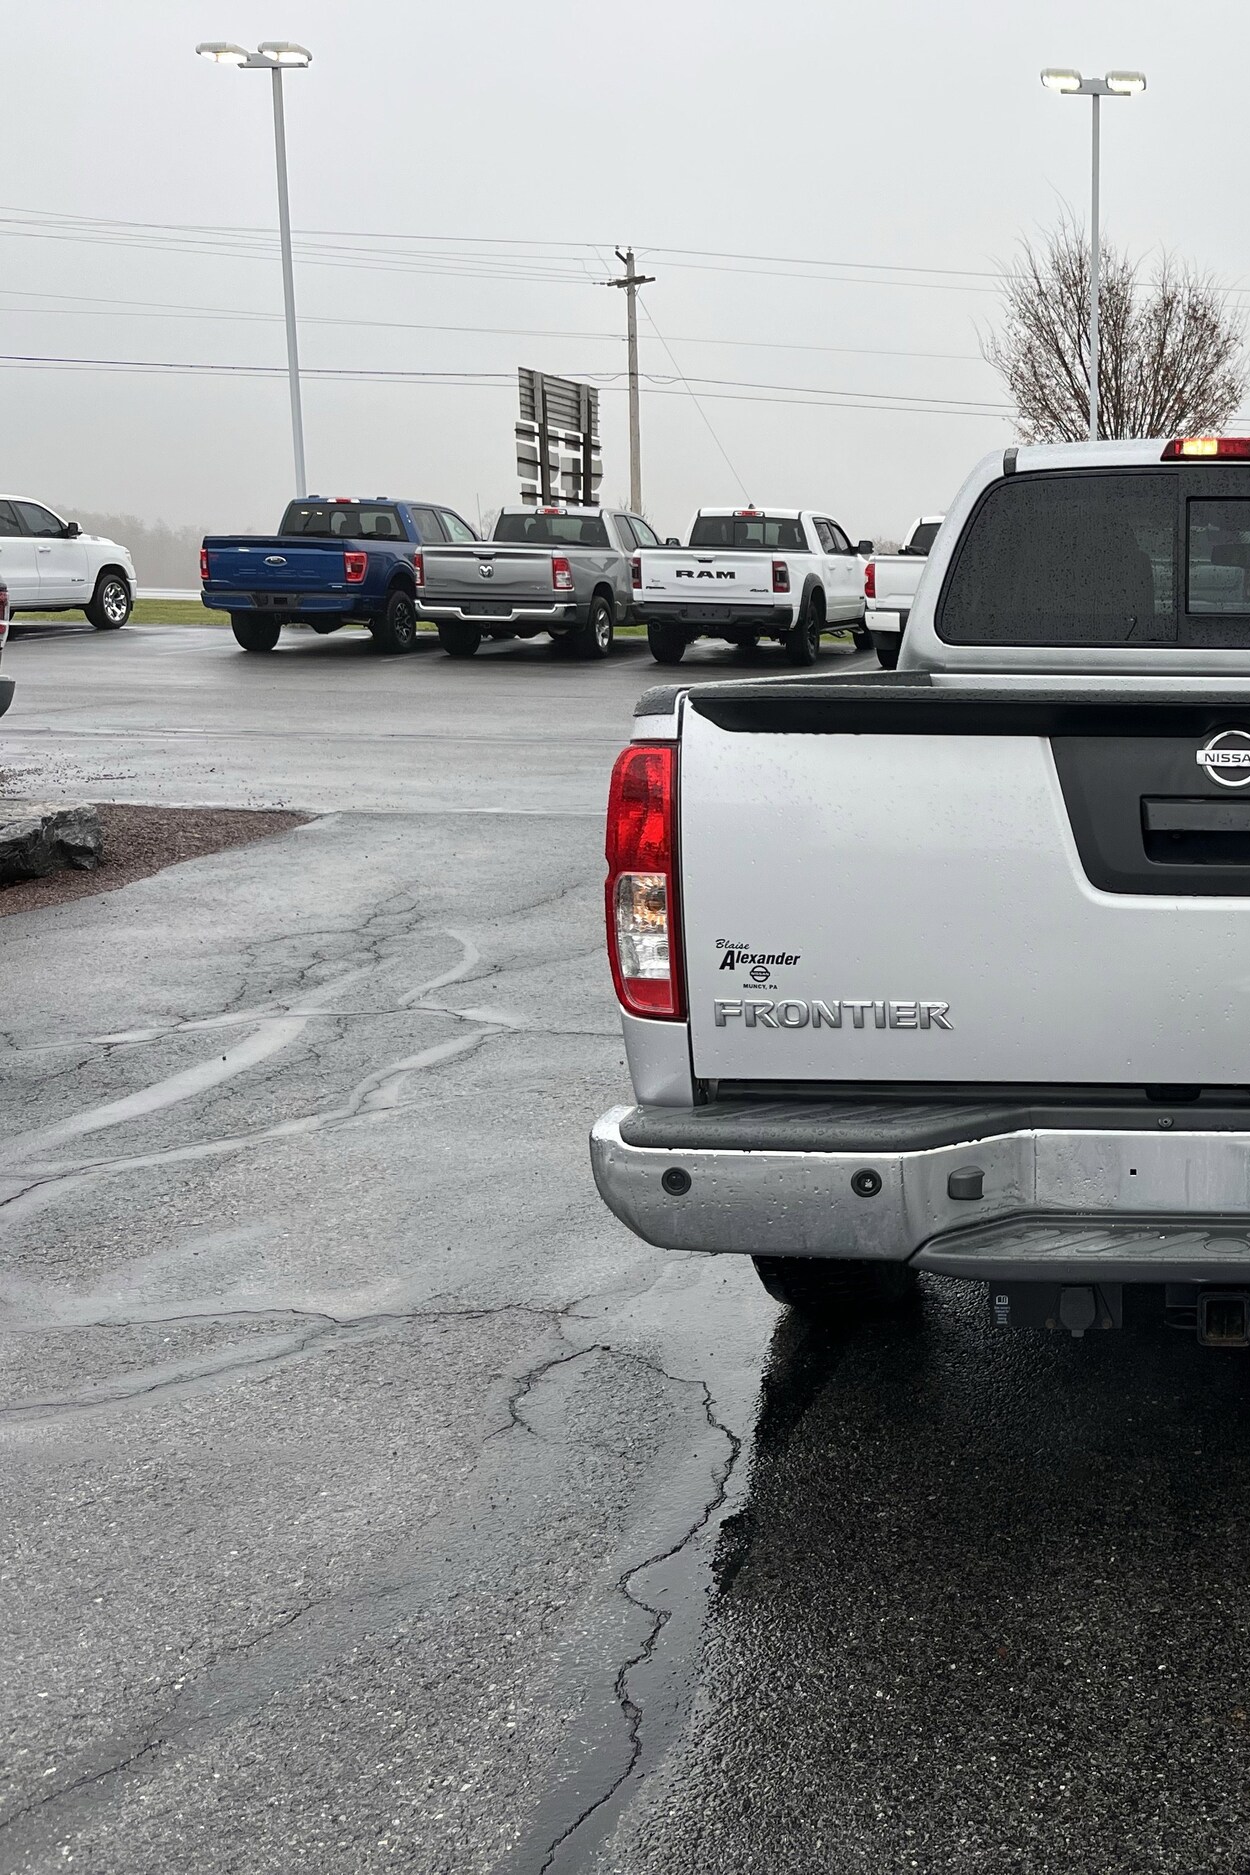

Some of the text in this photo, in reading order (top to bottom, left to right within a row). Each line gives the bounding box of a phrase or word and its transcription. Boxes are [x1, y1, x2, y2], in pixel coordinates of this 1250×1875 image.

[676, 570, 736, 579] RAM
[715, 938, 750, 950] Blaise
[719, 950, 800, 971] Alexander
[714, 998, 954, 1030] FRONTIER
